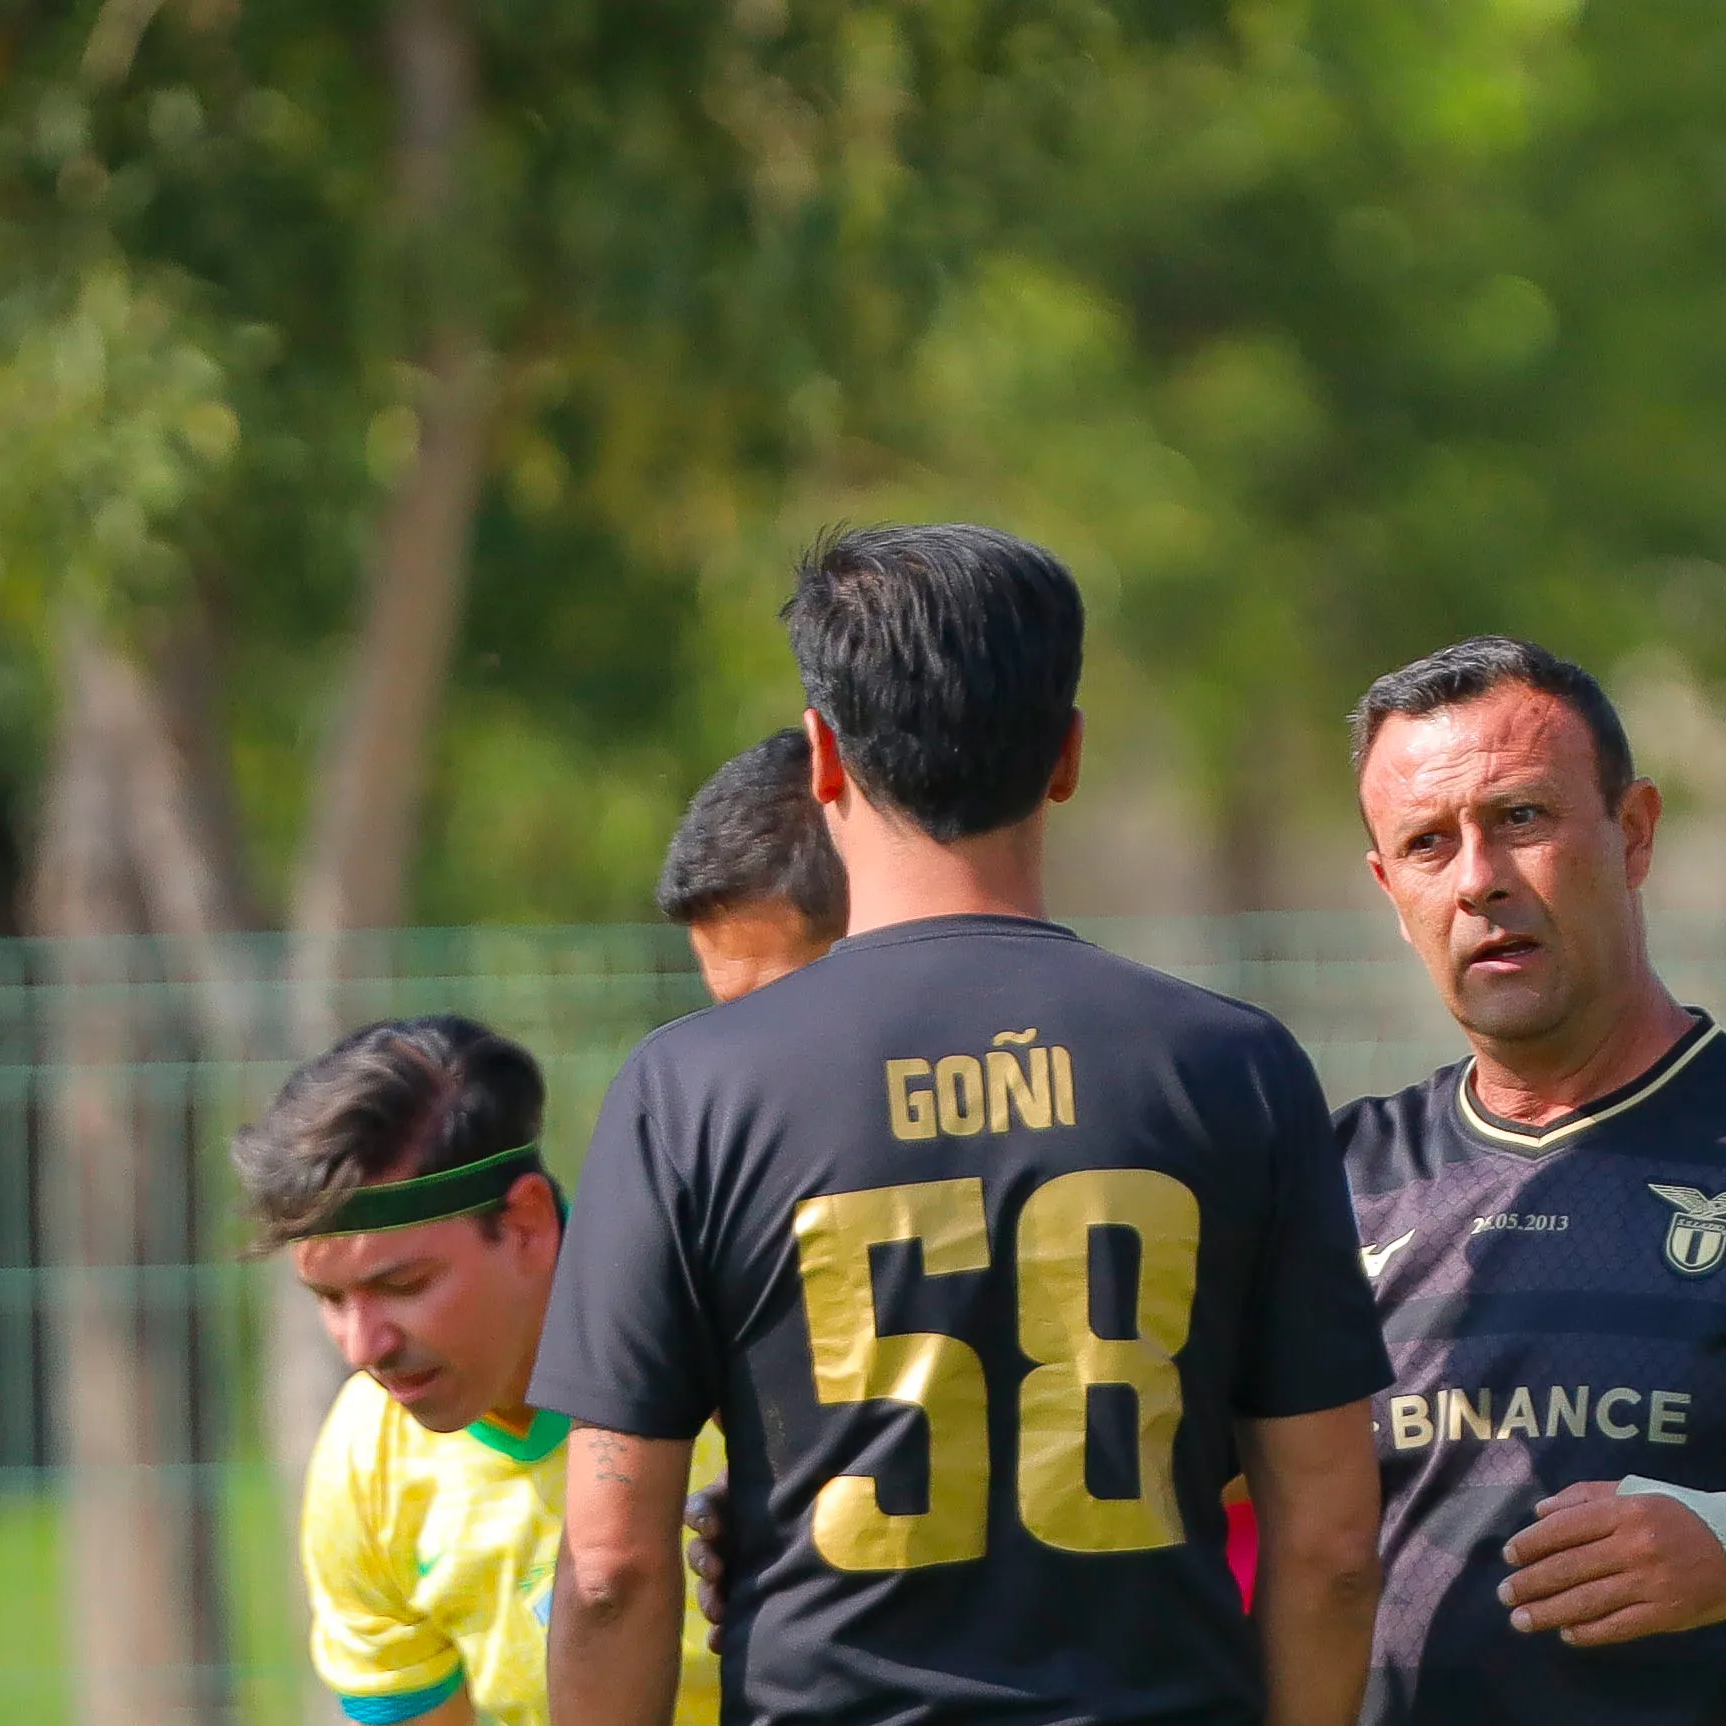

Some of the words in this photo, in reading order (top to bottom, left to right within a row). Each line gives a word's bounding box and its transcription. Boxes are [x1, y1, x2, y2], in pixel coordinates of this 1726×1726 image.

[885, 1027, 1076, 1141] GOÑI
[794, 1169, 1201, 1572] 58
[1390, 1385, 1692, 1450] BINANCE
